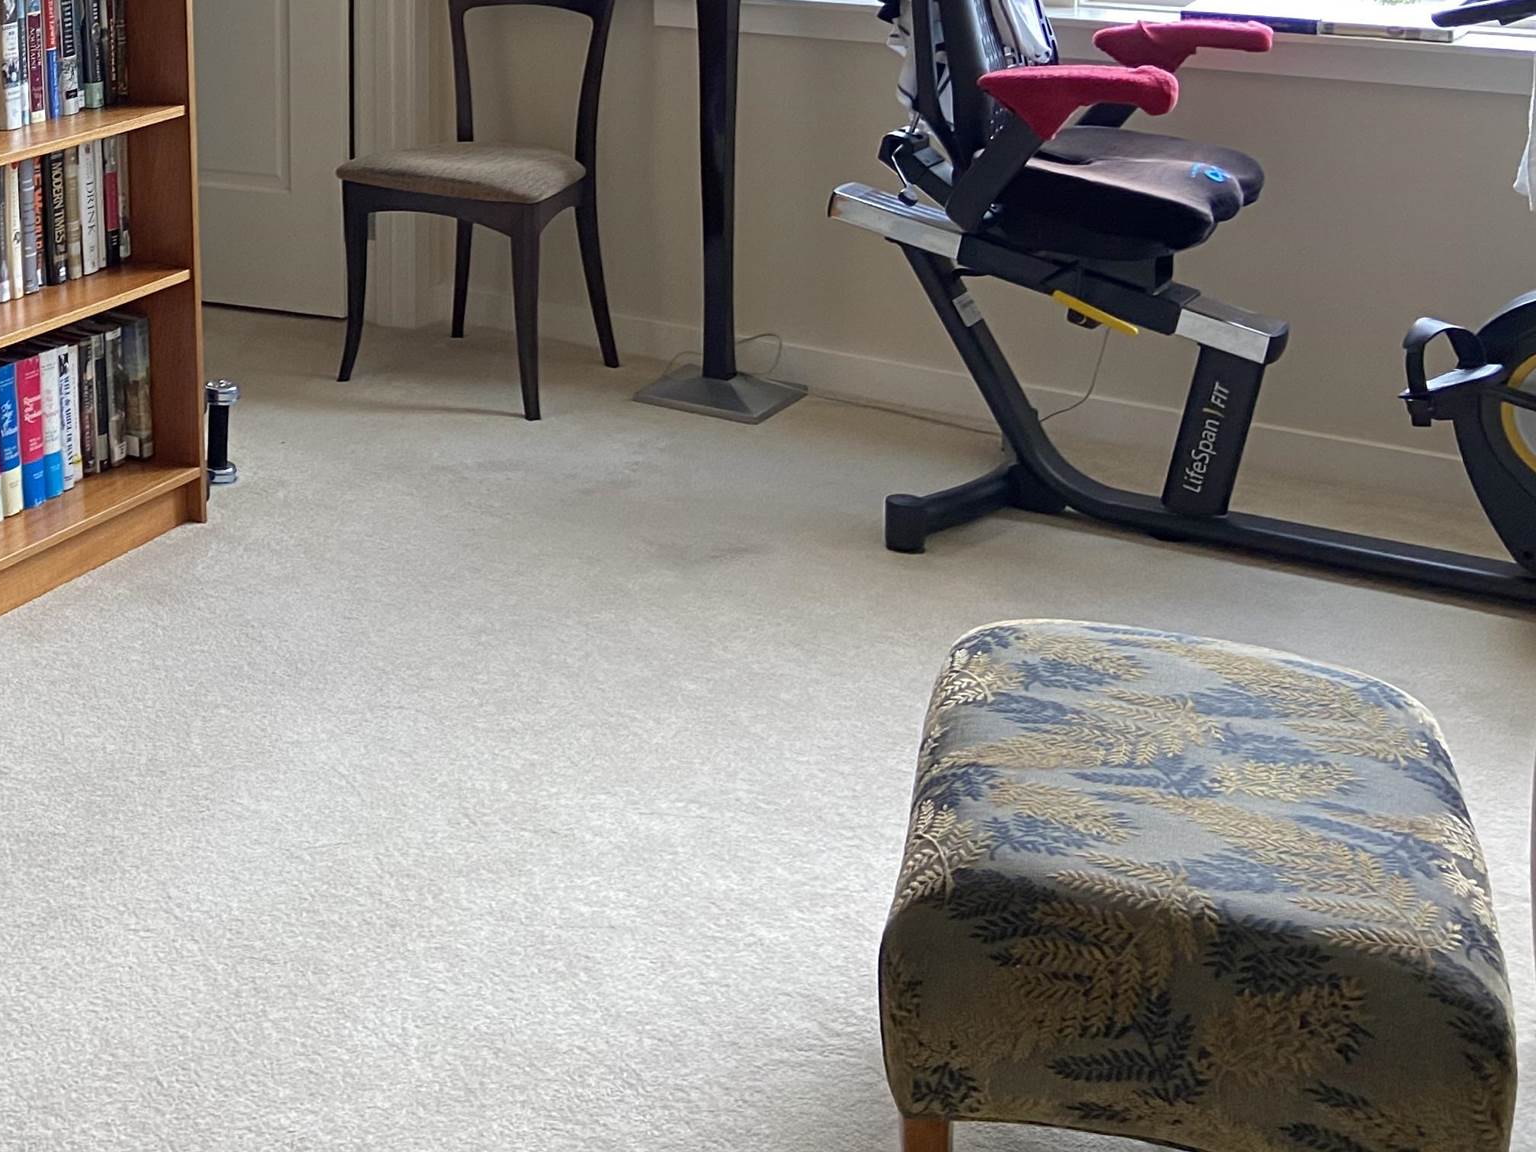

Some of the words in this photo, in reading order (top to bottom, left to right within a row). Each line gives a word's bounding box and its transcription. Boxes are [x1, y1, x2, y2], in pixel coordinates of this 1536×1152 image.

[50, 161, 64, 209] MODERN
[85, 181, 96, 235] DRINK
[54, 208, 66, 243] TIMES
[1182, 419, 1221, 494] LifeSpan
[1210, 381, 1230, 409] FIT
